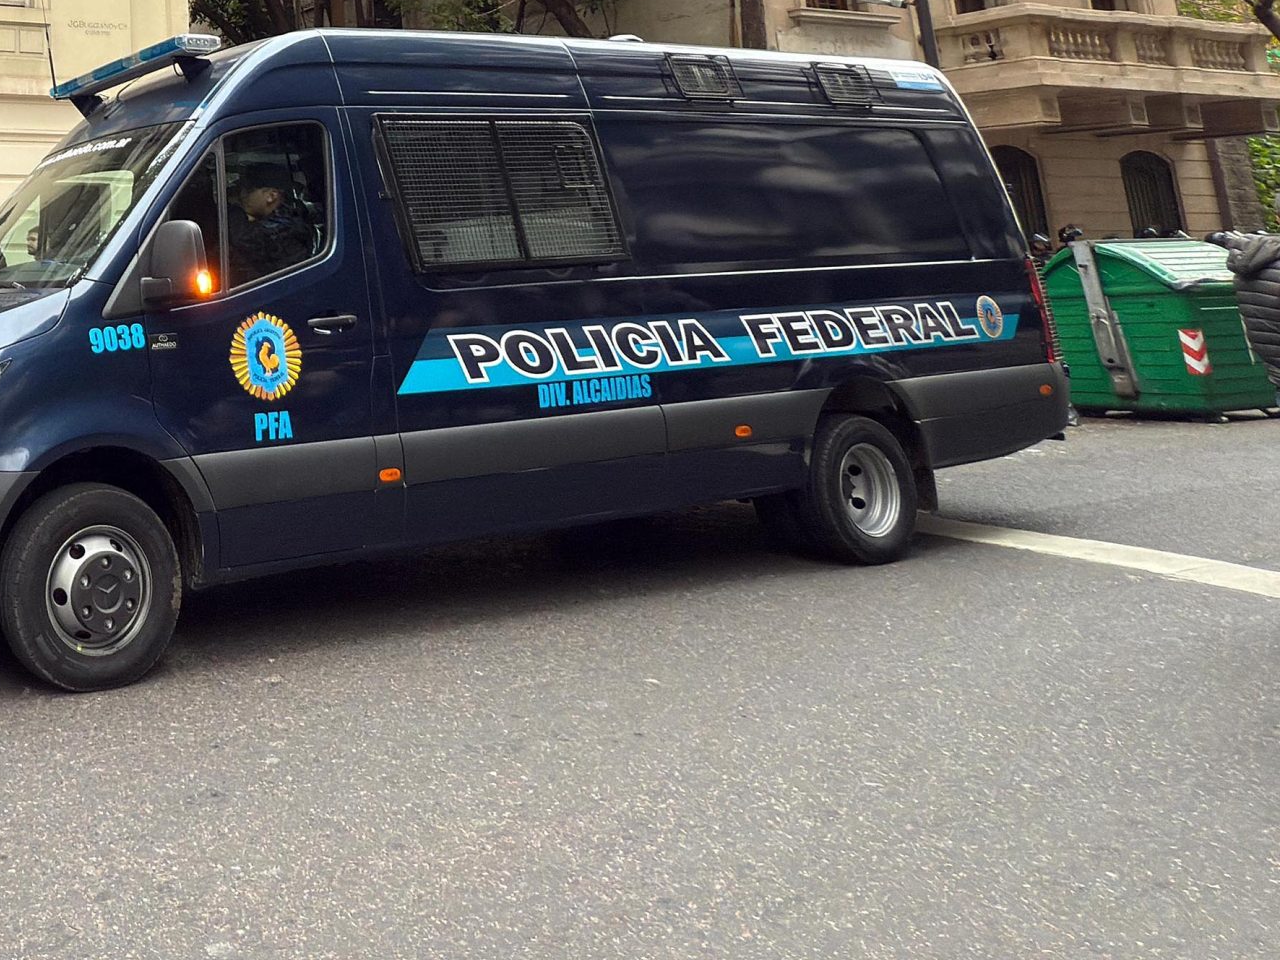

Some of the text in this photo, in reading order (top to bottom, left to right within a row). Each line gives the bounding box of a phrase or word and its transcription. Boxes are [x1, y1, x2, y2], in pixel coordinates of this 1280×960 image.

[89, 323, 146, 354] 9038
[447, 301, 980, 384] POLICIA FEDERAL
[537, 374, 652, 408] DIV. ALCAIDIAS
[254, 410, 293, 442] PFA
